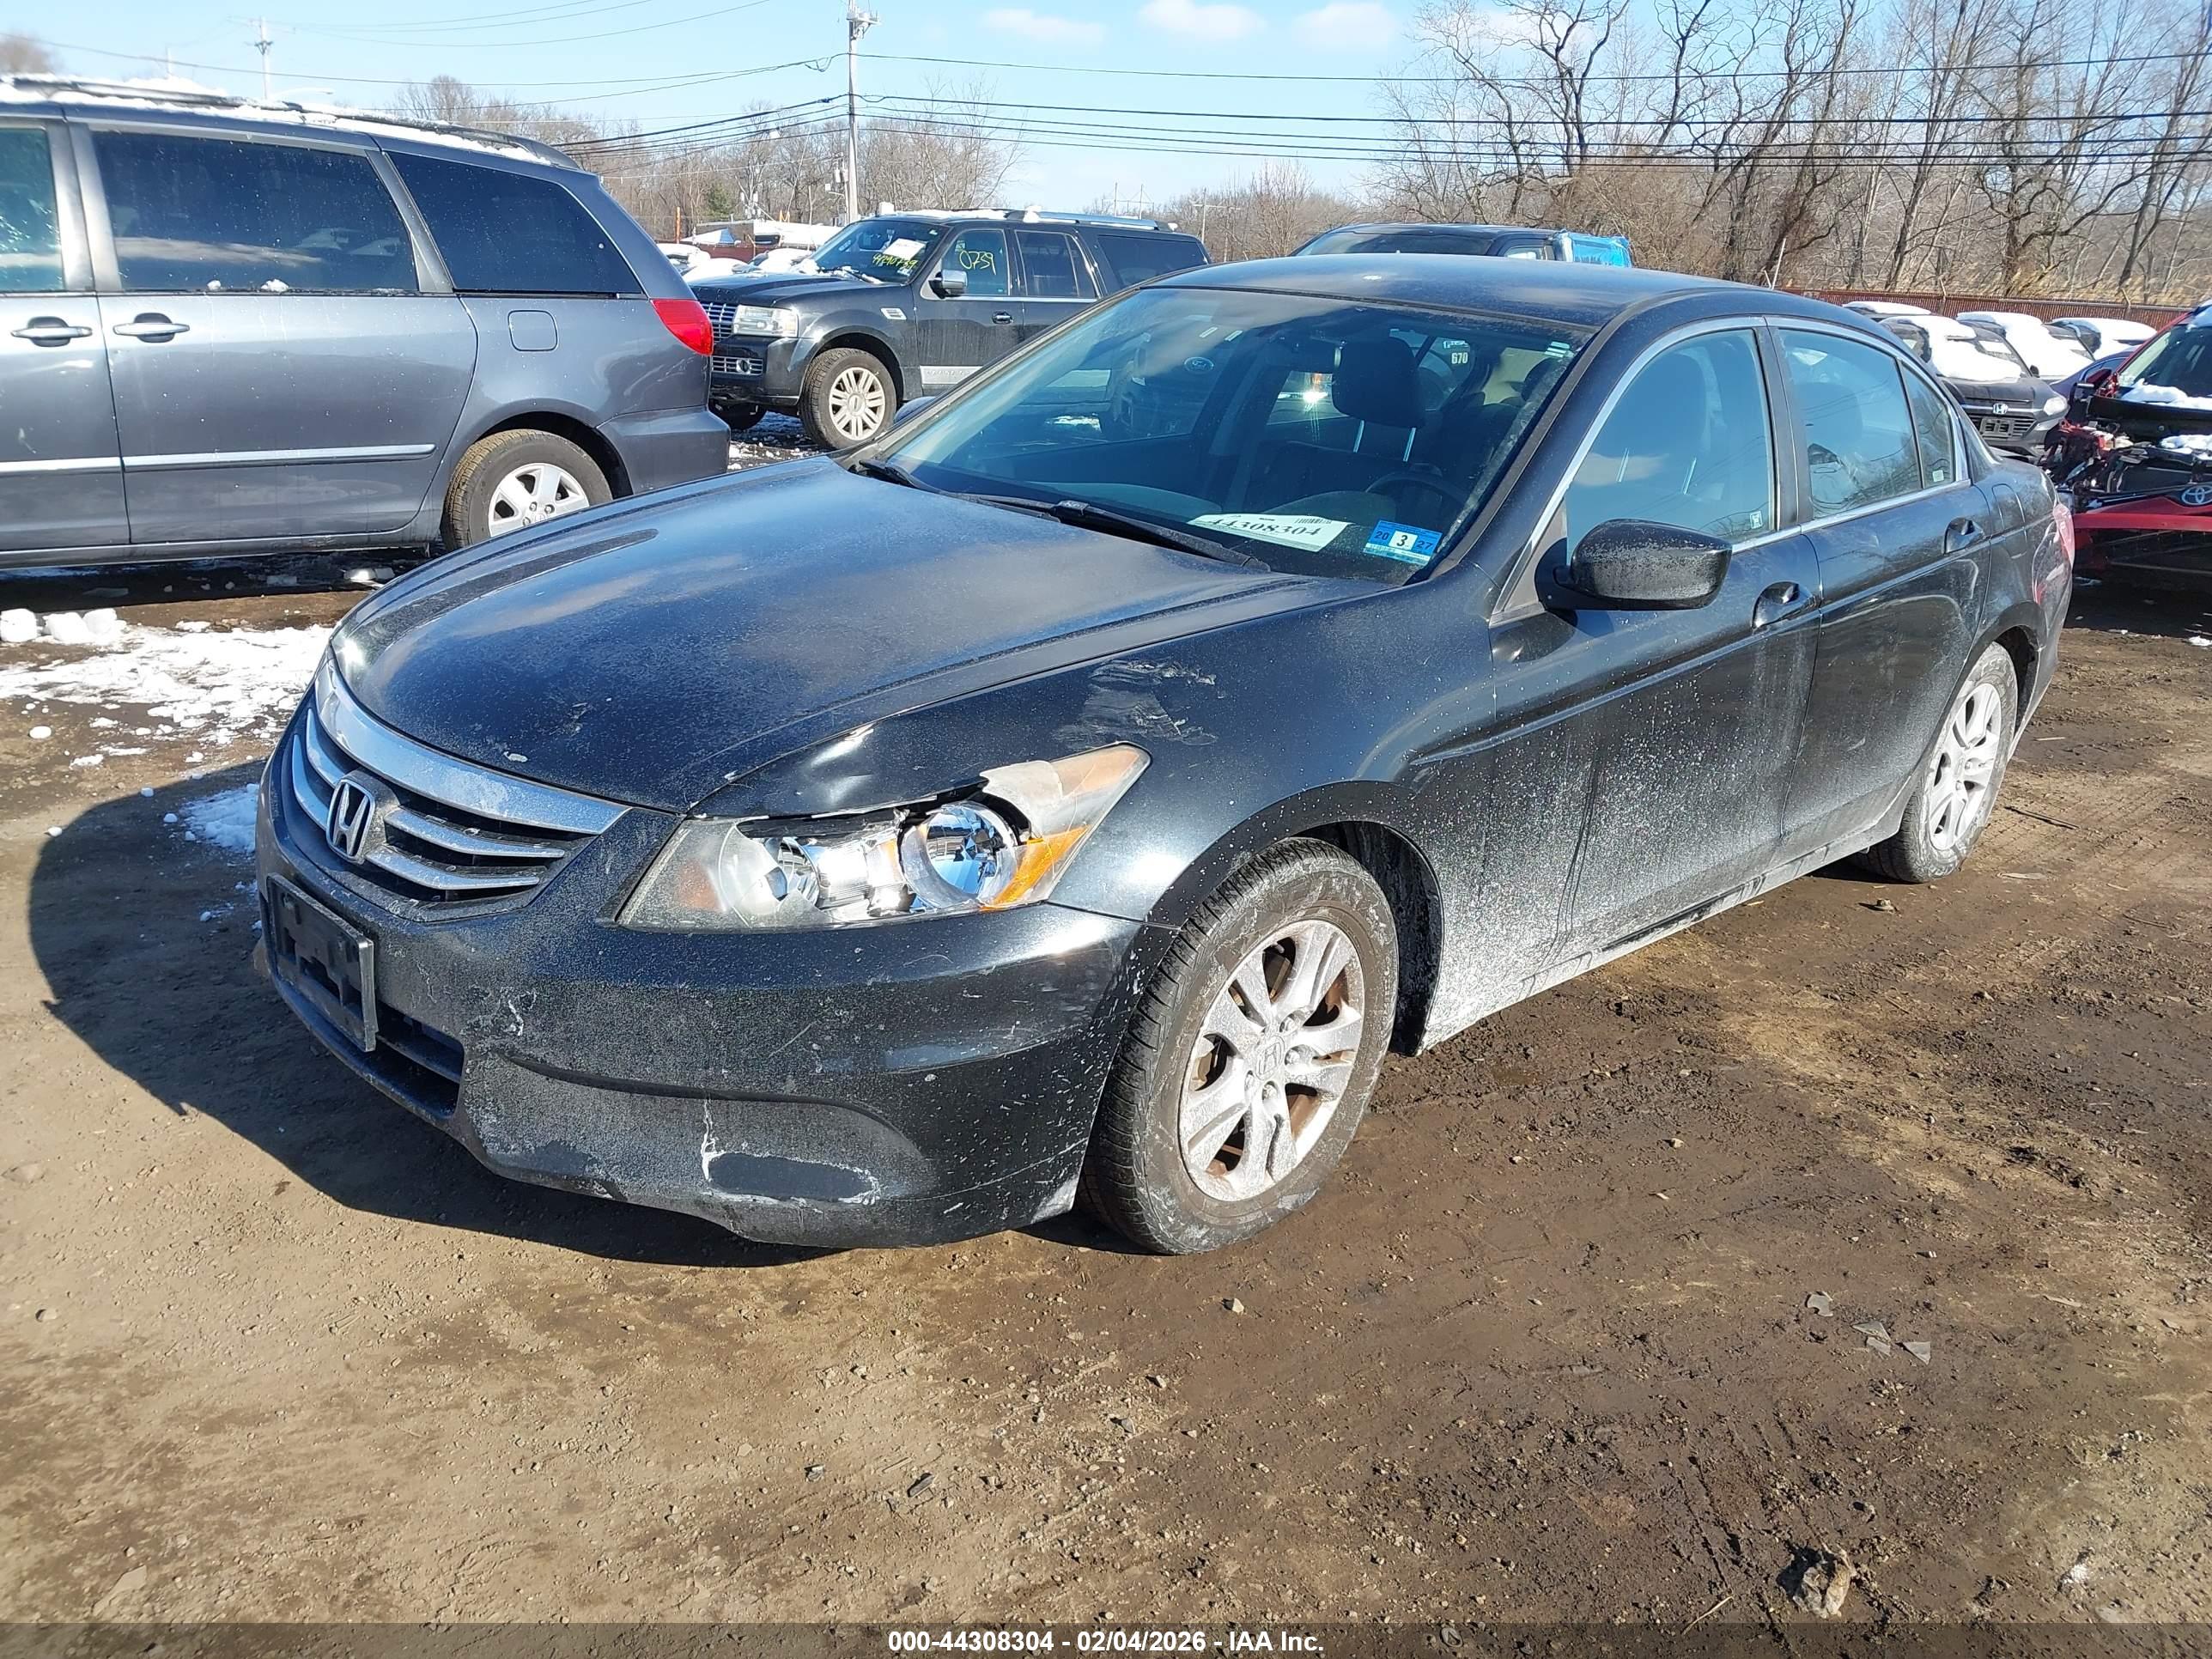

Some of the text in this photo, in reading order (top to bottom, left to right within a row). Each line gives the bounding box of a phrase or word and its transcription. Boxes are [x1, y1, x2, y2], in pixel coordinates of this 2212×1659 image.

[1451, 352, 1468, 365] 670
[1210, 518, 1322, 536] 44308304
[1375, 531, 1433, 550] 20 3 27
